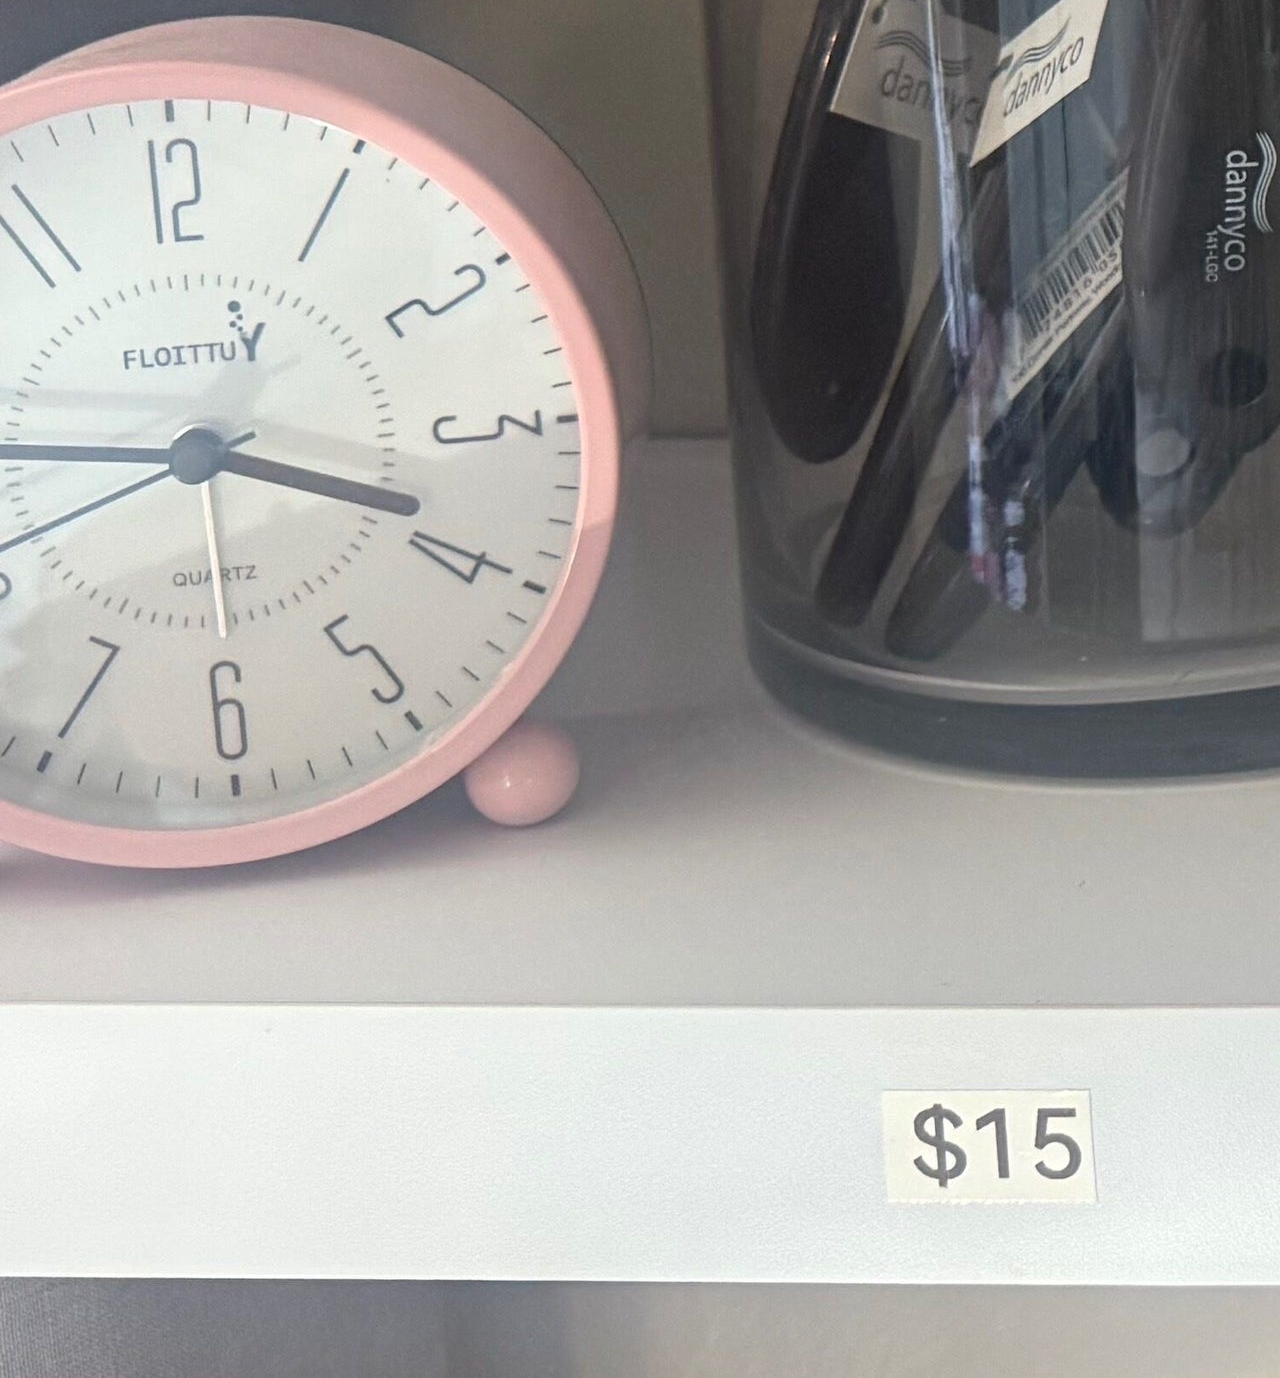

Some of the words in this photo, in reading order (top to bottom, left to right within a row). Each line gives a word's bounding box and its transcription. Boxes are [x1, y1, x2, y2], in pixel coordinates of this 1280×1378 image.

[1003, 35, 1085, 119] dannyco
[148, 137, 204, 244] 12
[1216, 149, 1259, 272] dannyco
[385, 263, 486, 339] 2
[432, 409, 543, 444] 3
[409, 530, 514, 584] 4
[58, 636, 121, 739] 7
[323, 614, 405, 705] 5
[209, 660, 248, 761] 6
[912, 1102, 1083, 1189] $15
